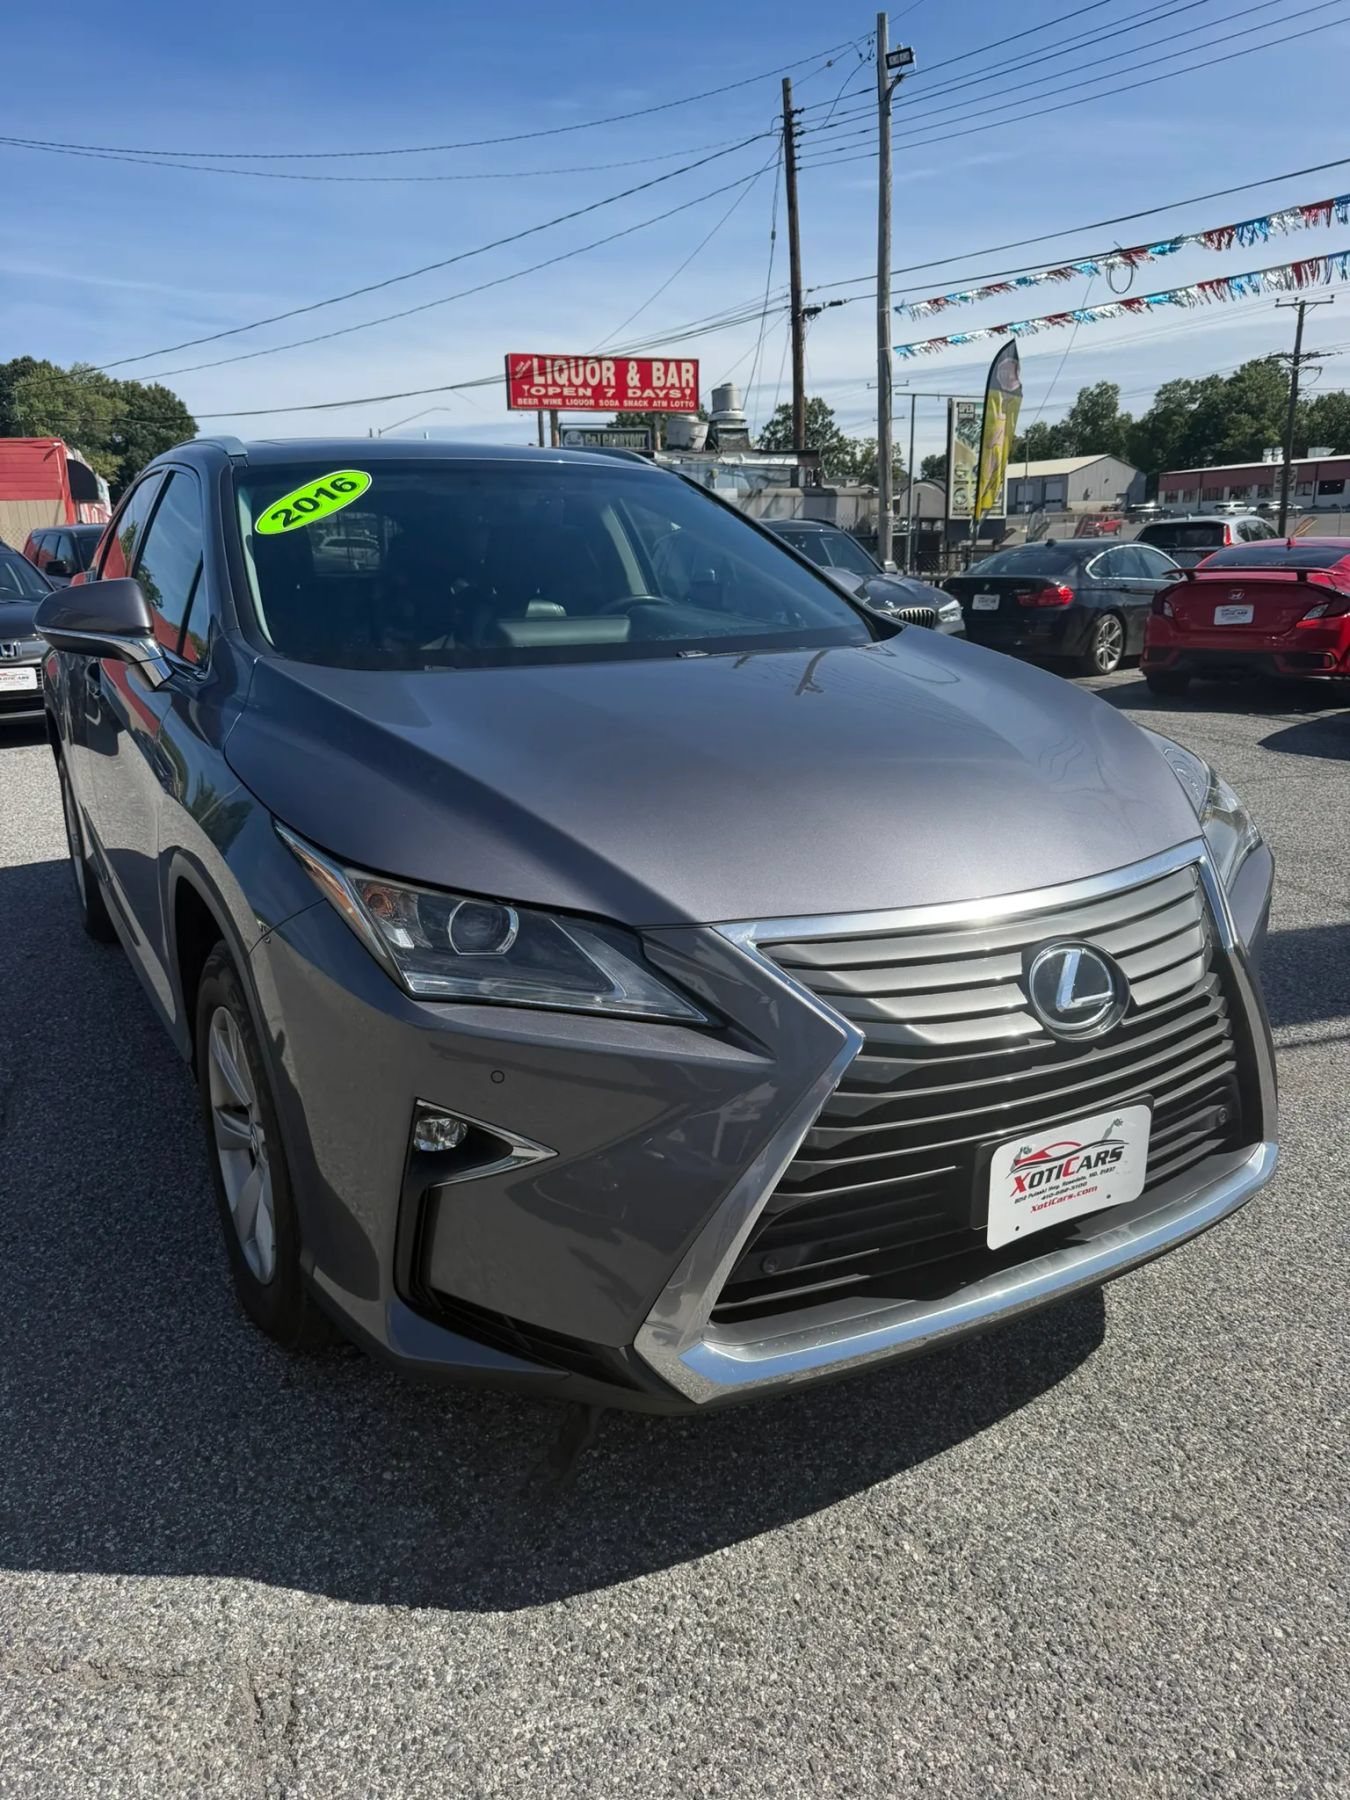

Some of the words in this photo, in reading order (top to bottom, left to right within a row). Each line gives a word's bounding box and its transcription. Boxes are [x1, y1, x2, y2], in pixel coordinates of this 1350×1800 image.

[532, 357, 616, 387] LIQUOR
[626, 360, 641, 388] &
[652, 360, 695, 388] BAR
[517, 397, 539, 406] BEER
[542, 397, 563, 406] WINE
[565, 398, 595, 406] LIQUOR
[598, 399, 620, 407] SODA
[623, 399, 649, 407] SNACK
[652, 400, 668, 408] ATM
[670, 400, 695, 408] LOTTO
[530, 386, 593, 396] OPEN
[604, 388, 616, 398] 7
[271, 477, 358, 528] 2016
[1031, 1186, 1098, 1213] XotiCars.com
